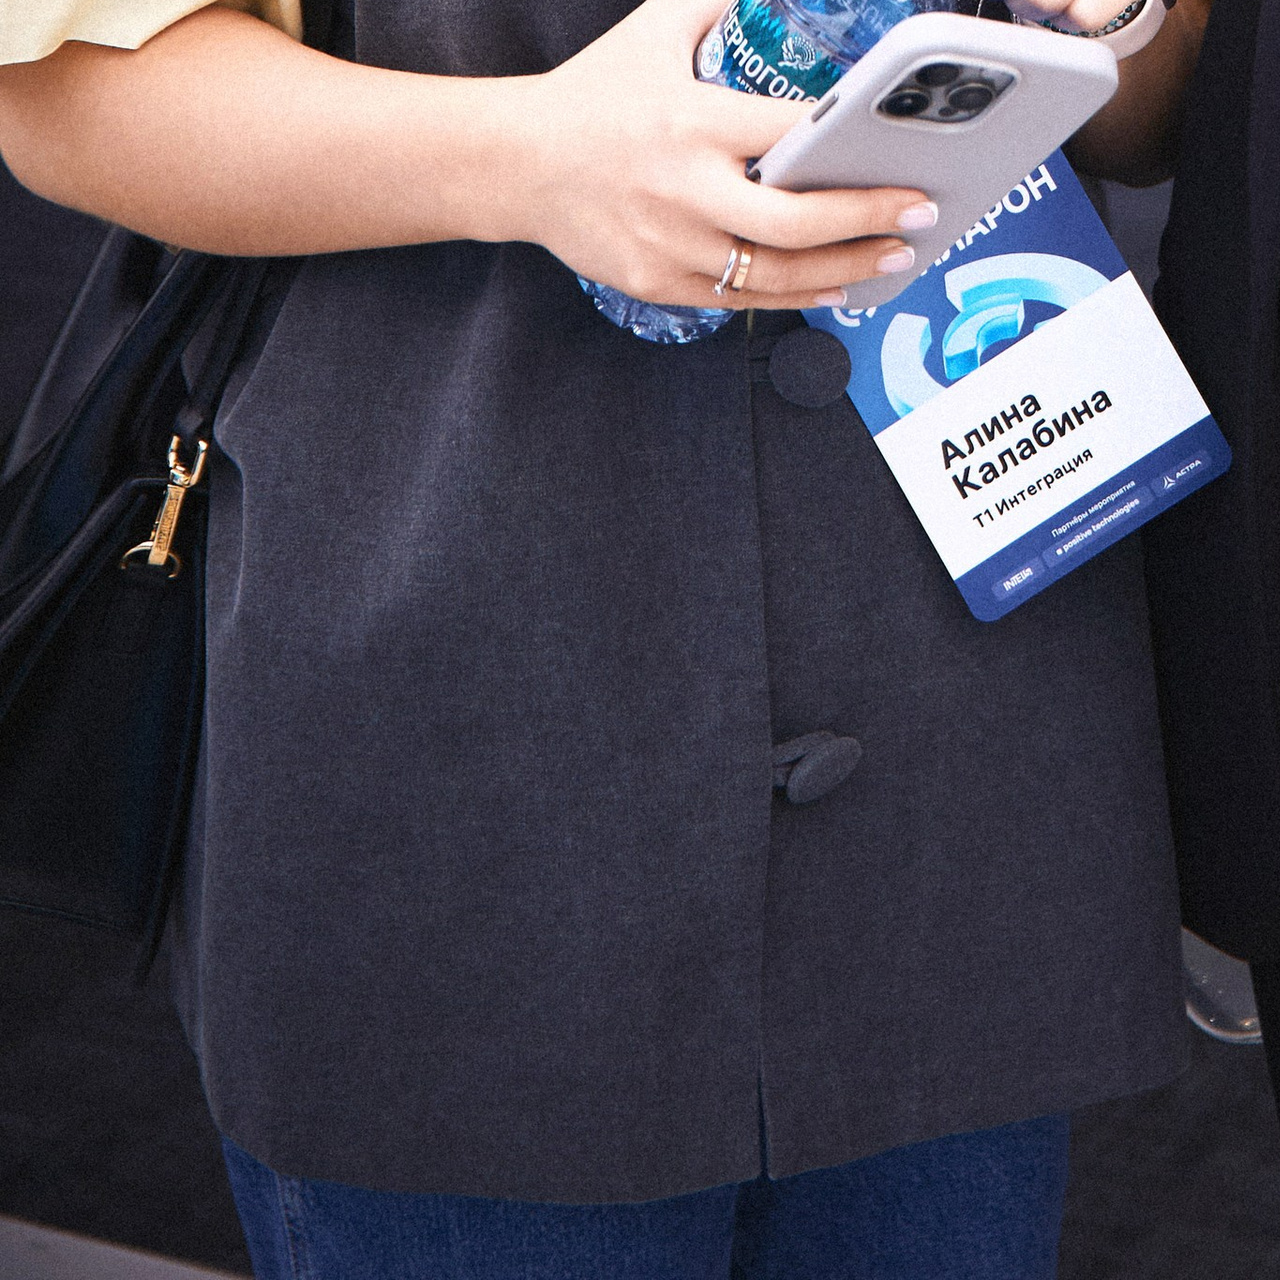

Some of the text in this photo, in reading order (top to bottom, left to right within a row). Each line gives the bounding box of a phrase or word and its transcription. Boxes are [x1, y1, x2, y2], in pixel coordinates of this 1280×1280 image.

[723, 0, 819, 102] ЧЕРНОГОЛ
[941, 394, 1042, 470] Алина
[951, 390, 1112, 500] Калабина
[1175, 459, 1202, 479] АСТРА
[972, 448, 1094, 528] Т1 Интеграция
[1051, 480, 1136, 538] Партнёры мероприятия
[1062, 497, 1140, 555] positive technologies
